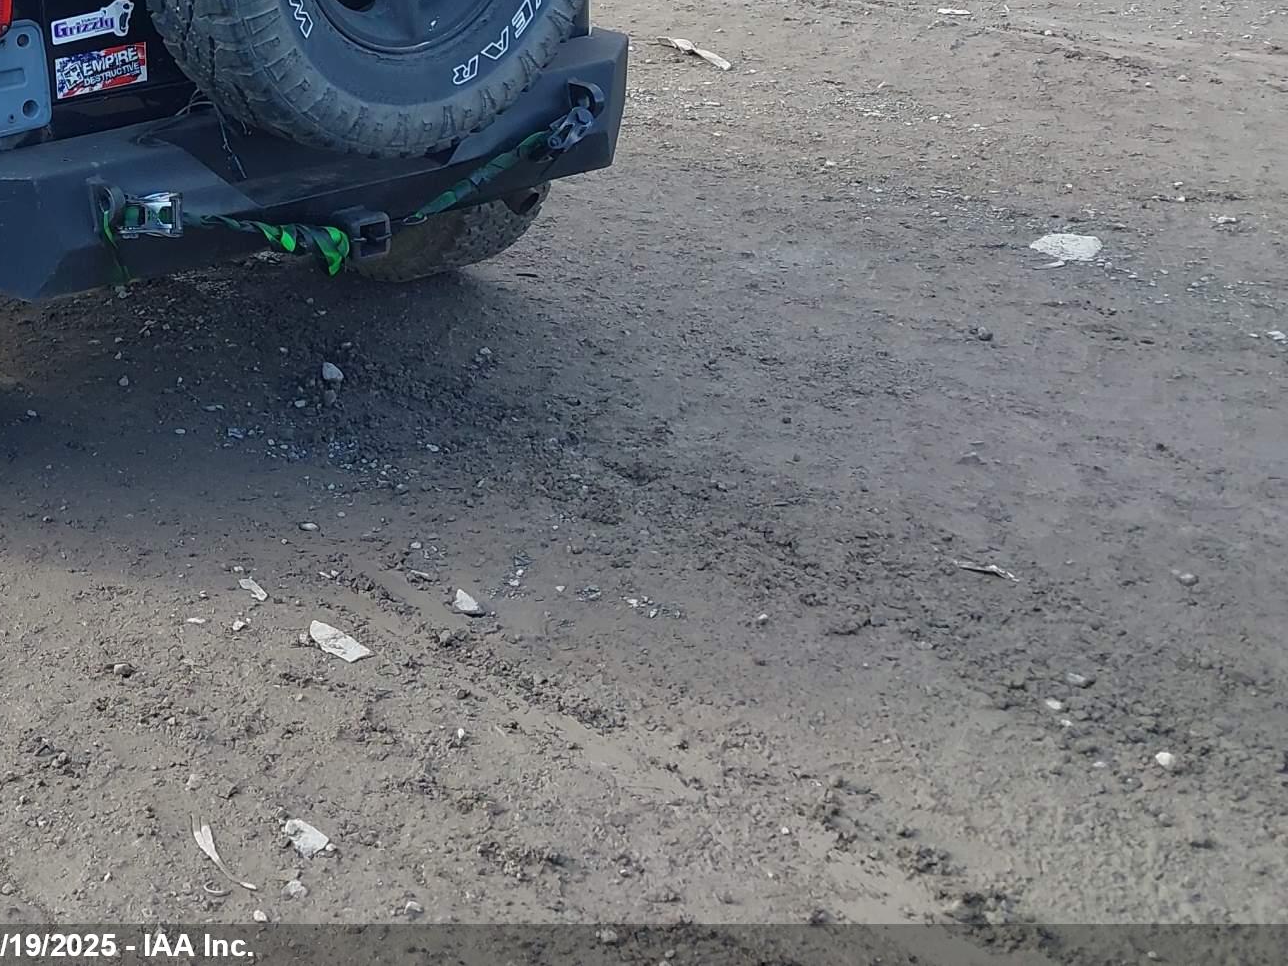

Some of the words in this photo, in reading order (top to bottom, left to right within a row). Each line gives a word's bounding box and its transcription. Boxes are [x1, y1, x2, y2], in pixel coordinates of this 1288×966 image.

[53, 16, 115, 38] Grizzly
[82, 47, 139, 75] EMPIRE
[83, 61, 141, 87] DESTRUCTIVE
